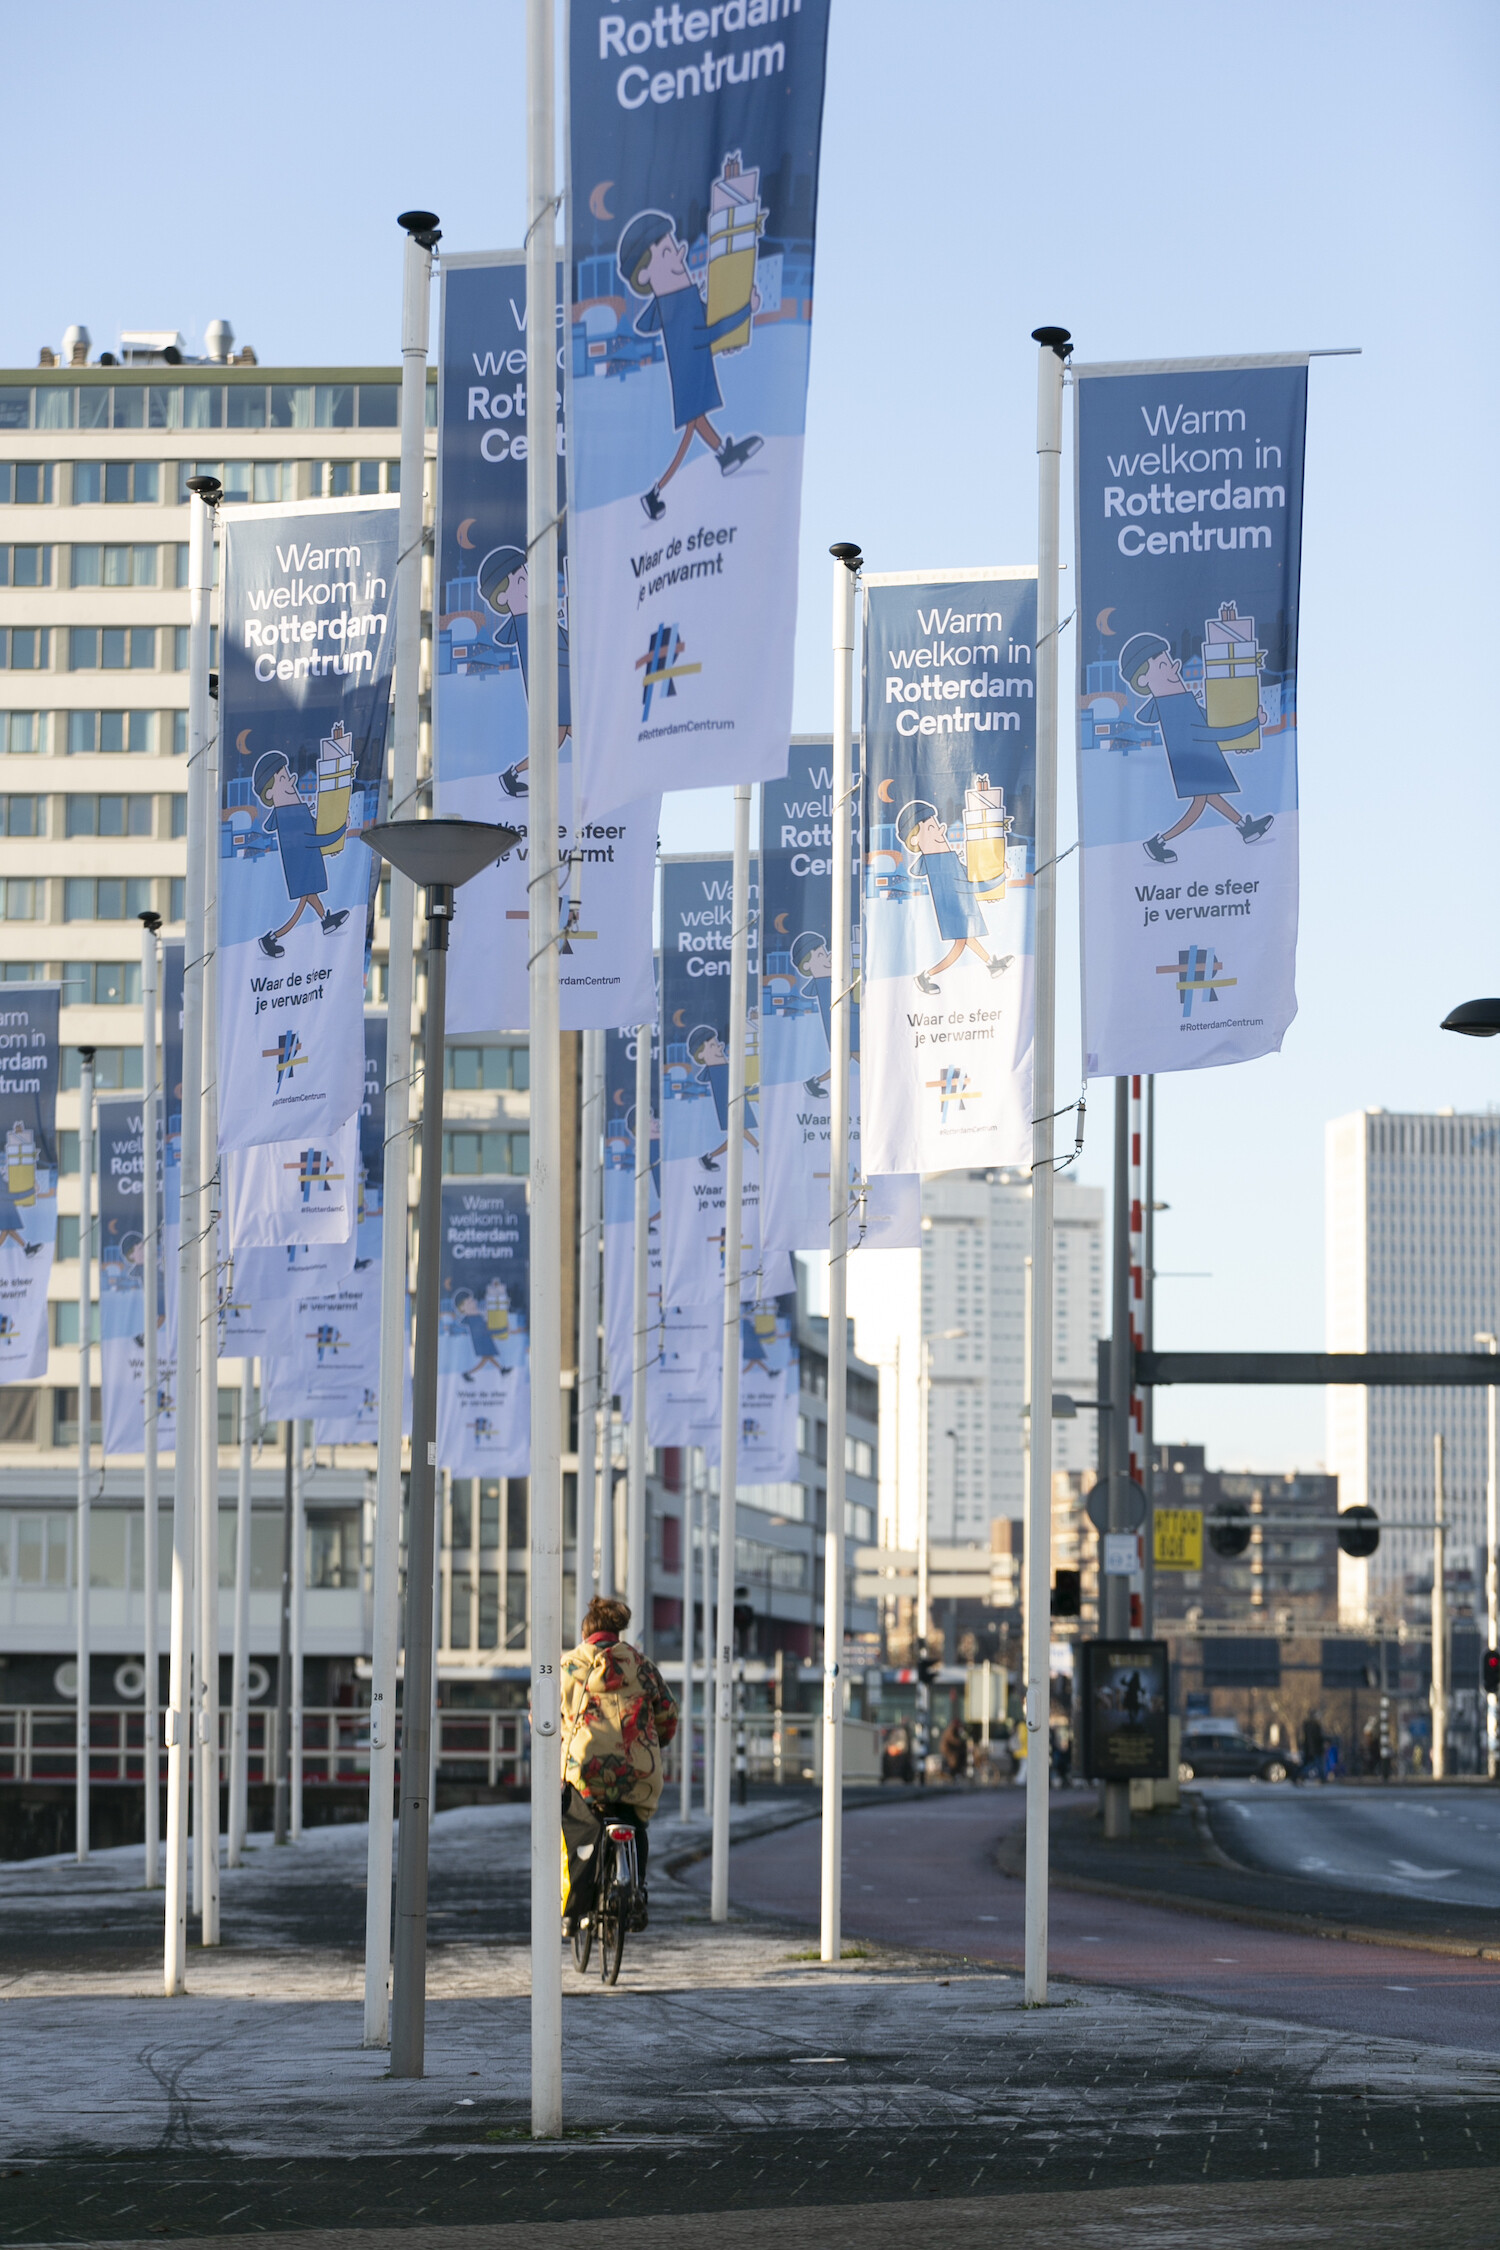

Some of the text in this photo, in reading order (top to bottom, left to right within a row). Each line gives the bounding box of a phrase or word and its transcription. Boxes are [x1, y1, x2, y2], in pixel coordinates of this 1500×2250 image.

[617, 41, 785, 110] Centrum
[1141, 404, 1246, 437] Warm
[1107, 438, 1282, 477] welkom in
[1104, 479, 1286, 518] Rotterdam
[666, 537, 682, 561] de
[687, 527, 738, 552] sfeer
[1117, 521, 1272, 557] Centrum
[276, 542, 361, 573] Warm
[648, 552, 724, 597] verwarmt
[248, 572, 386, 611] welkom in
[244, 611, 388, 649] Rotterdam
[917, 608, 1002, 635] Warm
[254, 649, 373, 683] Centrum
[889, 637, 1031, 670] welkom in
[885, 672, 1034, 704] Rotterdam
[896, 706, 1021, 736] Centrum
[1135, 879, 1260, 902] Waar de sfeer
[1143, 899, 1251, 927] je verwarmt
[250, 976, 284, 992] Waar
[286, 972, 302, 987] de
[255, 997, 268, 1015] je
[907, 1009, 1002, 1027] Waar de sfeer
[31, 1028, 46, 1047] in
[915, 1025, 995, 1048] je verwarmt
[1180, 1018, 1264, 1032] #RotterdamCentrum
[803, 1128, 815, 1144] je
[693, 1185, 723, 1195] Waar
[699, 1199, 708, 1212] je
[452, 1244, 514, 1259] Centrum
[539, 1664, 553, 1674] 33
[374, 1693, 383, 1701] 28
